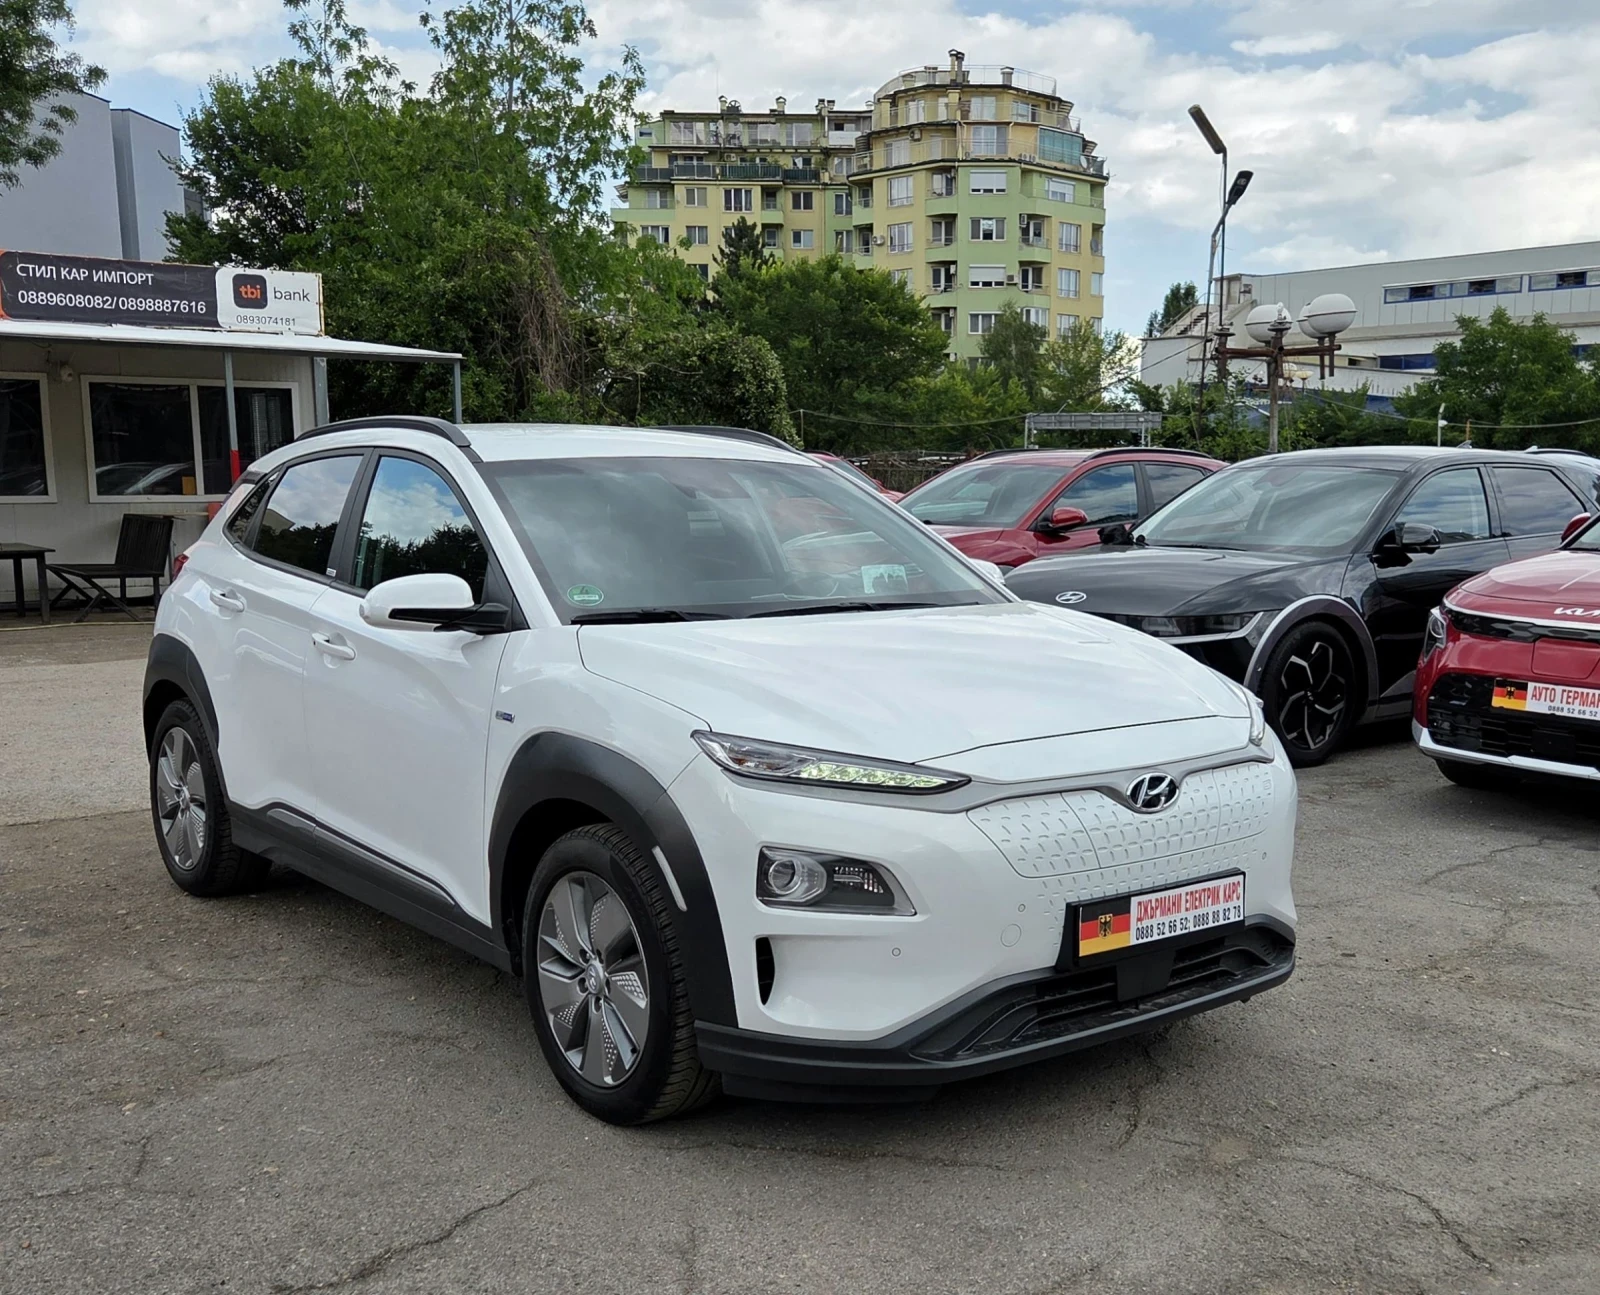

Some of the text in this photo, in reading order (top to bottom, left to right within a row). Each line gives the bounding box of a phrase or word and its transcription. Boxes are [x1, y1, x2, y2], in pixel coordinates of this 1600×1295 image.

[17, 263, 155, 286] СТИЛ КАР ИМПОРТ
[239, 284, 311, 302] tbi bank
[236, 314, 296, 327] 0893074181
[1136, 881, 1241, 926] ДЖЪРМАНИ ЕЛЕКТРИК КАРС
[1136, 925, 1153, 940] 0888
[1157, 922, 1165, 936] 52
[1169, 919, 1177, 934] 66
[1193, 912, 1209, 928] 0888
[1212, 910, 1220, 924] 88
[1223, 908, 1230, 922] 82
